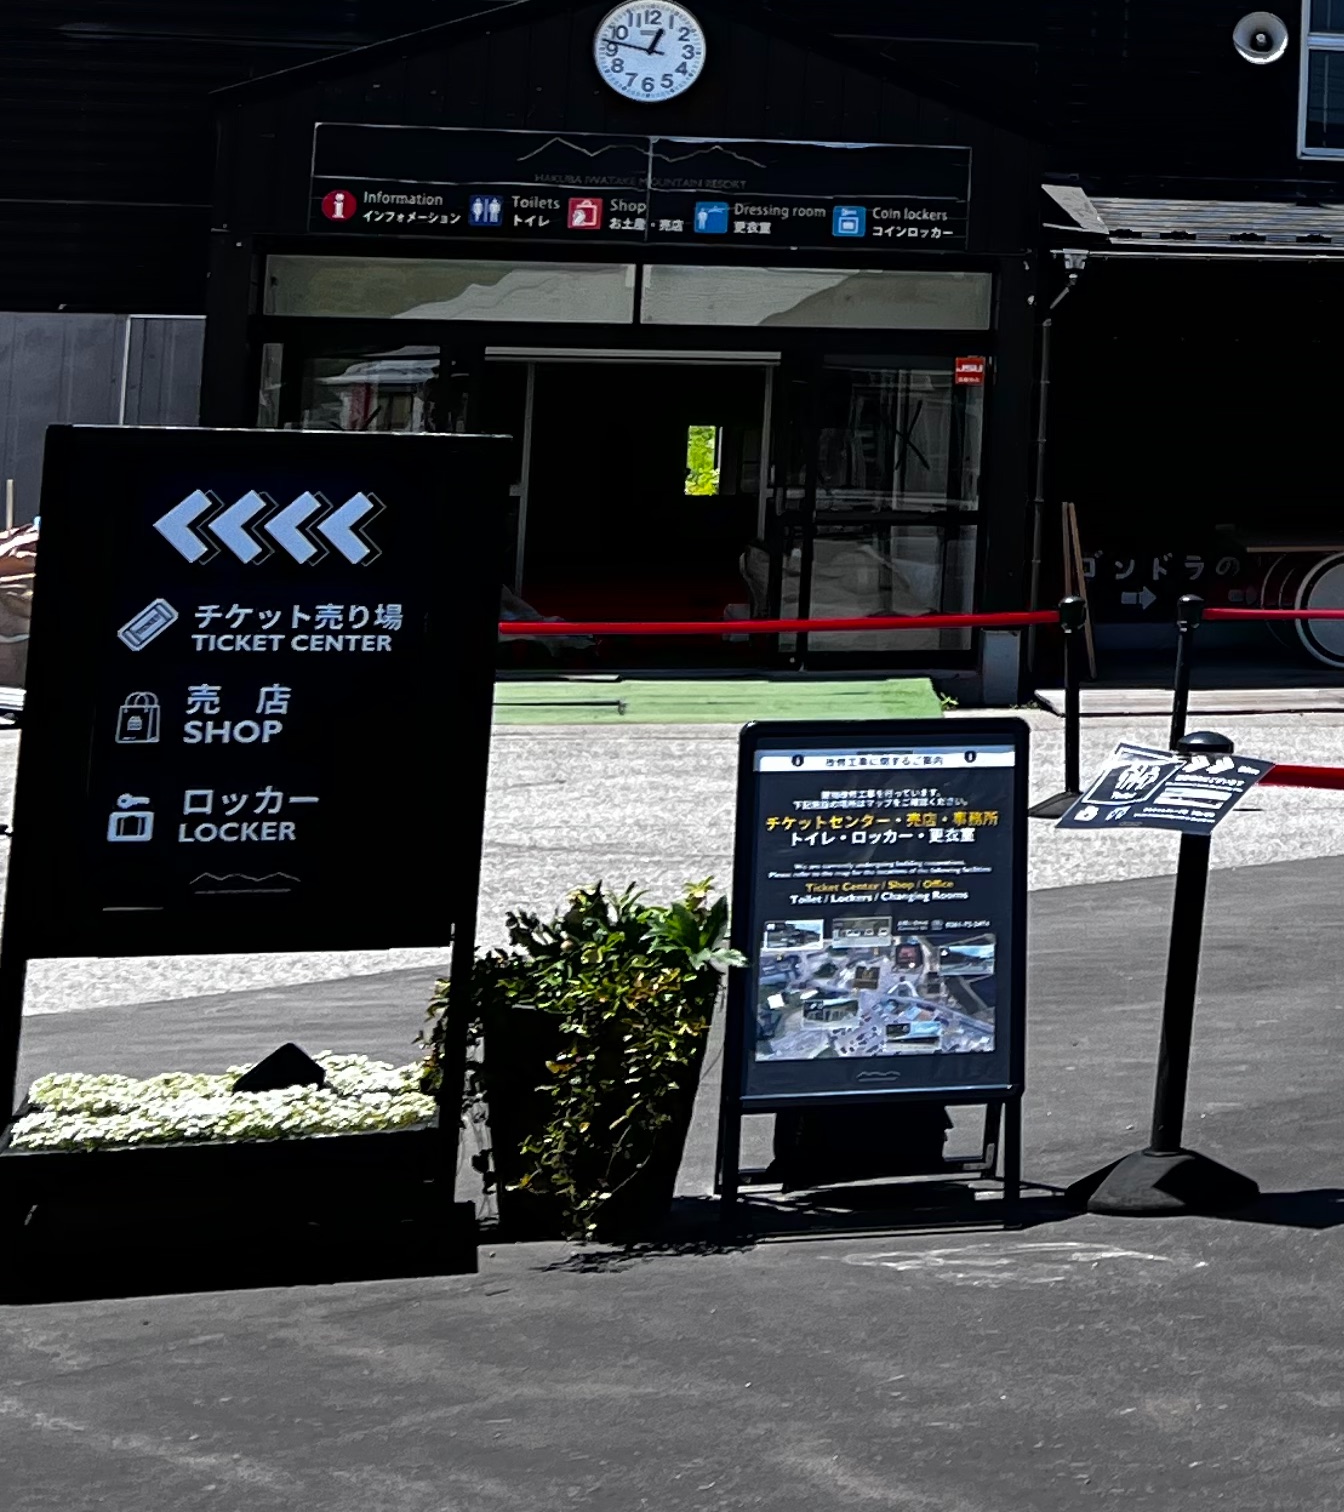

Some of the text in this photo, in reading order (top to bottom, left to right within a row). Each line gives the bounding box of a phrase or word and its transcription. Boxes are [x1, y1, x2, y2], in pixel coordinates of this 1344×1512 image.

[628, 12, 641, 28] 11
[645, 10, 662, 24] 12
[612, 25, 628, 40] 10
[678, 27, 690, 41] 2
[605, 42, 618, 57] 9
[682, 45, 694, 60] 3
[611, 58, 624, 73] 8
[675, 62, 688, 76] 4
[625, 73, 638, 87] 7
[641, 77, 654, 92] 6
[660, 74, 674, 88] 5
[364, 191, 443, 205] Information
[512, 195, 560, 210] Toilets
[610, 198, 647, 215] Shop
[734, 203, 826, 220] Dressing room
[872, 207, 947, 221] Coin lockers
[363, 210, 462, 224] インフォメーション
[513, 214, 550, 227] トイレ
[872, 226, 953, 238] コインロッカー
[194, 602, 404, 632] チケット売り場
[191, 634, 393, 652] TICKET CENTER
[186, 683, 292, 716] 売店
[183, 720, 283, 744] SHOP
[182, 785, 320, 816] ロッカー
[766, 811, 999, 831] チケットセンター・売店・事務所
[179, 822, 296, 843] LOCKER
[790, 828, 976, 847] トイレ・ロッカー・更衣室
[805, 883, 839, 893] Ticket
[842, 882, 880, 892] Center
[888, 880, 914, 890] Shop
[922, 879, 954, 888] Office
[790, 894, 823, 905] Toilet
[830, 892, 872, 903] Lockers
[880, 891, 930, 903] Changing
[932, 890, 969, 900] Rooms
